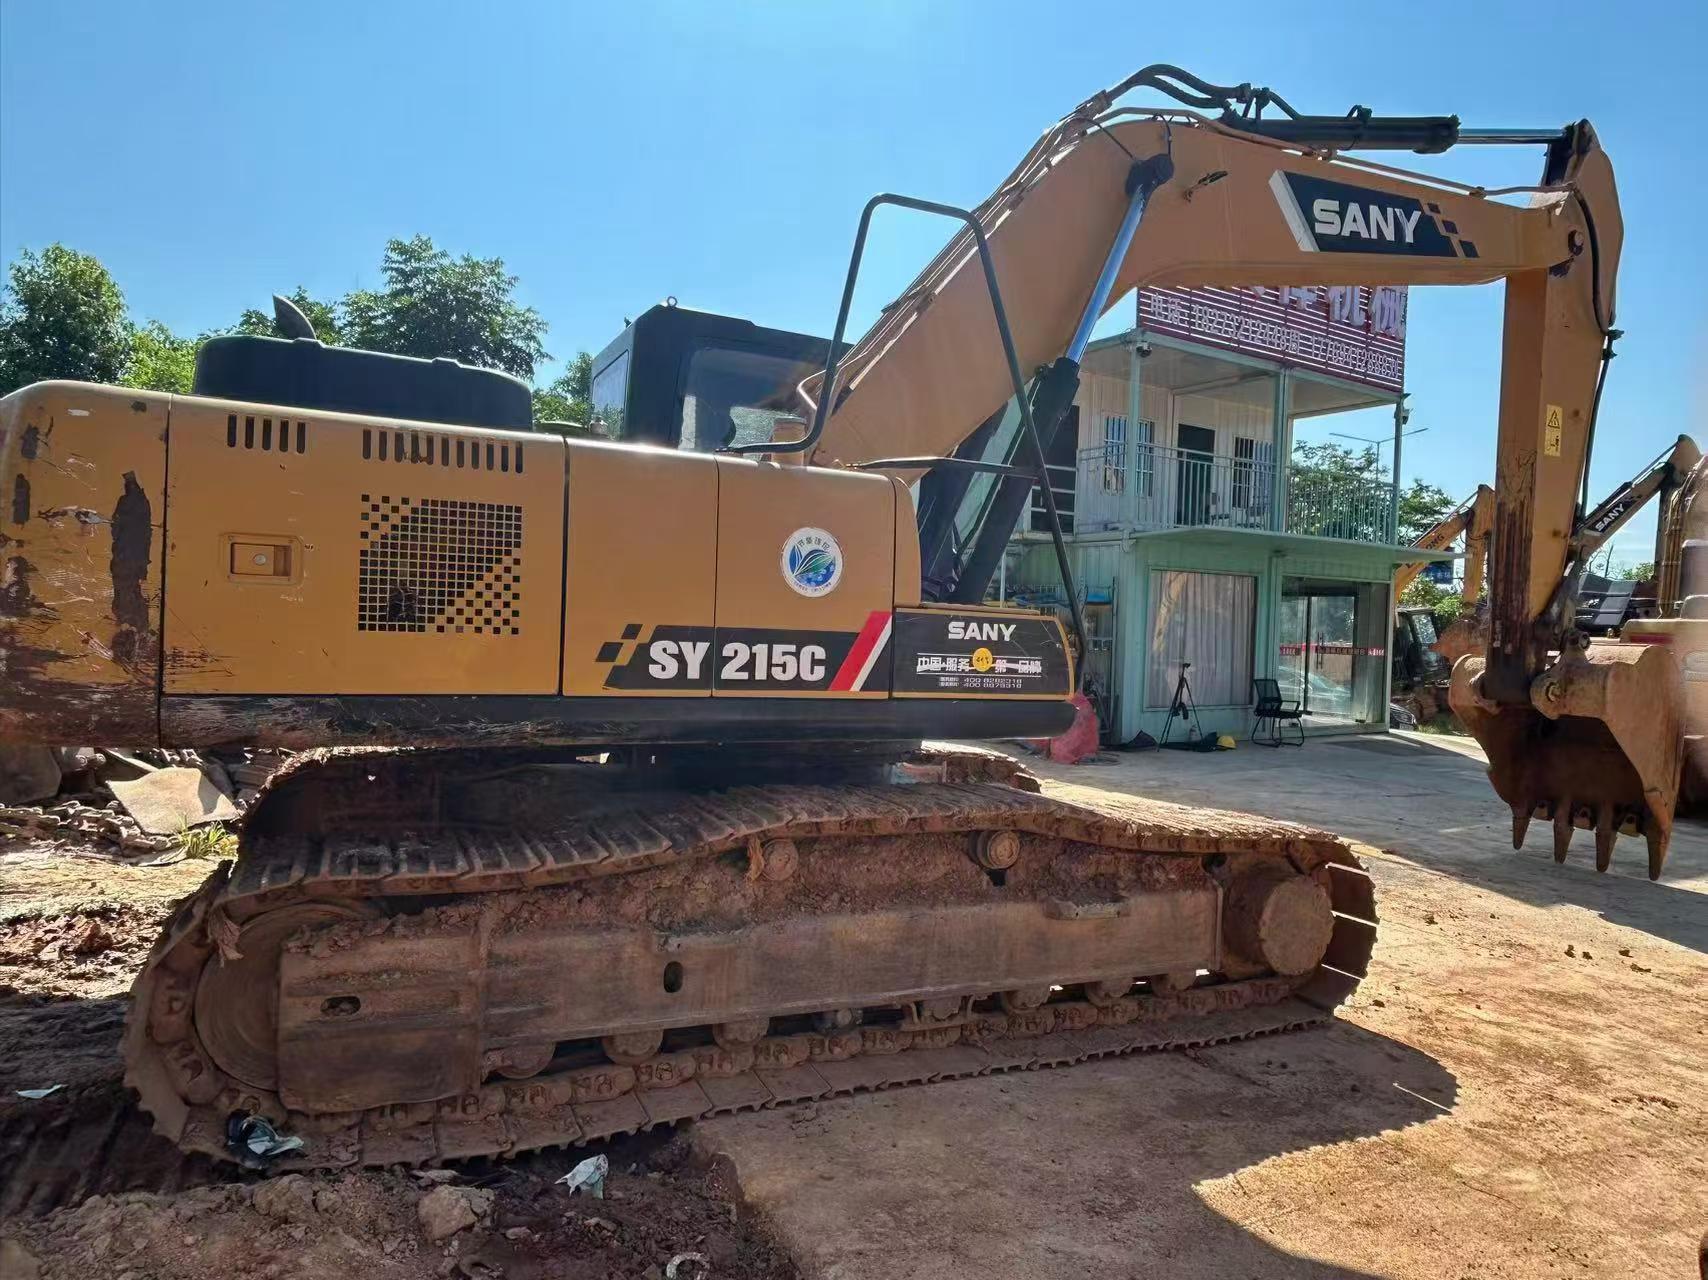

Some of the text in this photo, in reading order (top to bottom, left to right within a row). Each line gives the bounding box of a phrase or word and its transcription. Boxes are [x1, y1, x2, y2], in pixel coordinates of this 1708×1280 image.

[1313, 198, 1422, 244] SANY
[1595, 503, 1624, 532] SANY
[947, 621, 1017, 642] SANY
[648, 639, 827, 682] SY 215C
